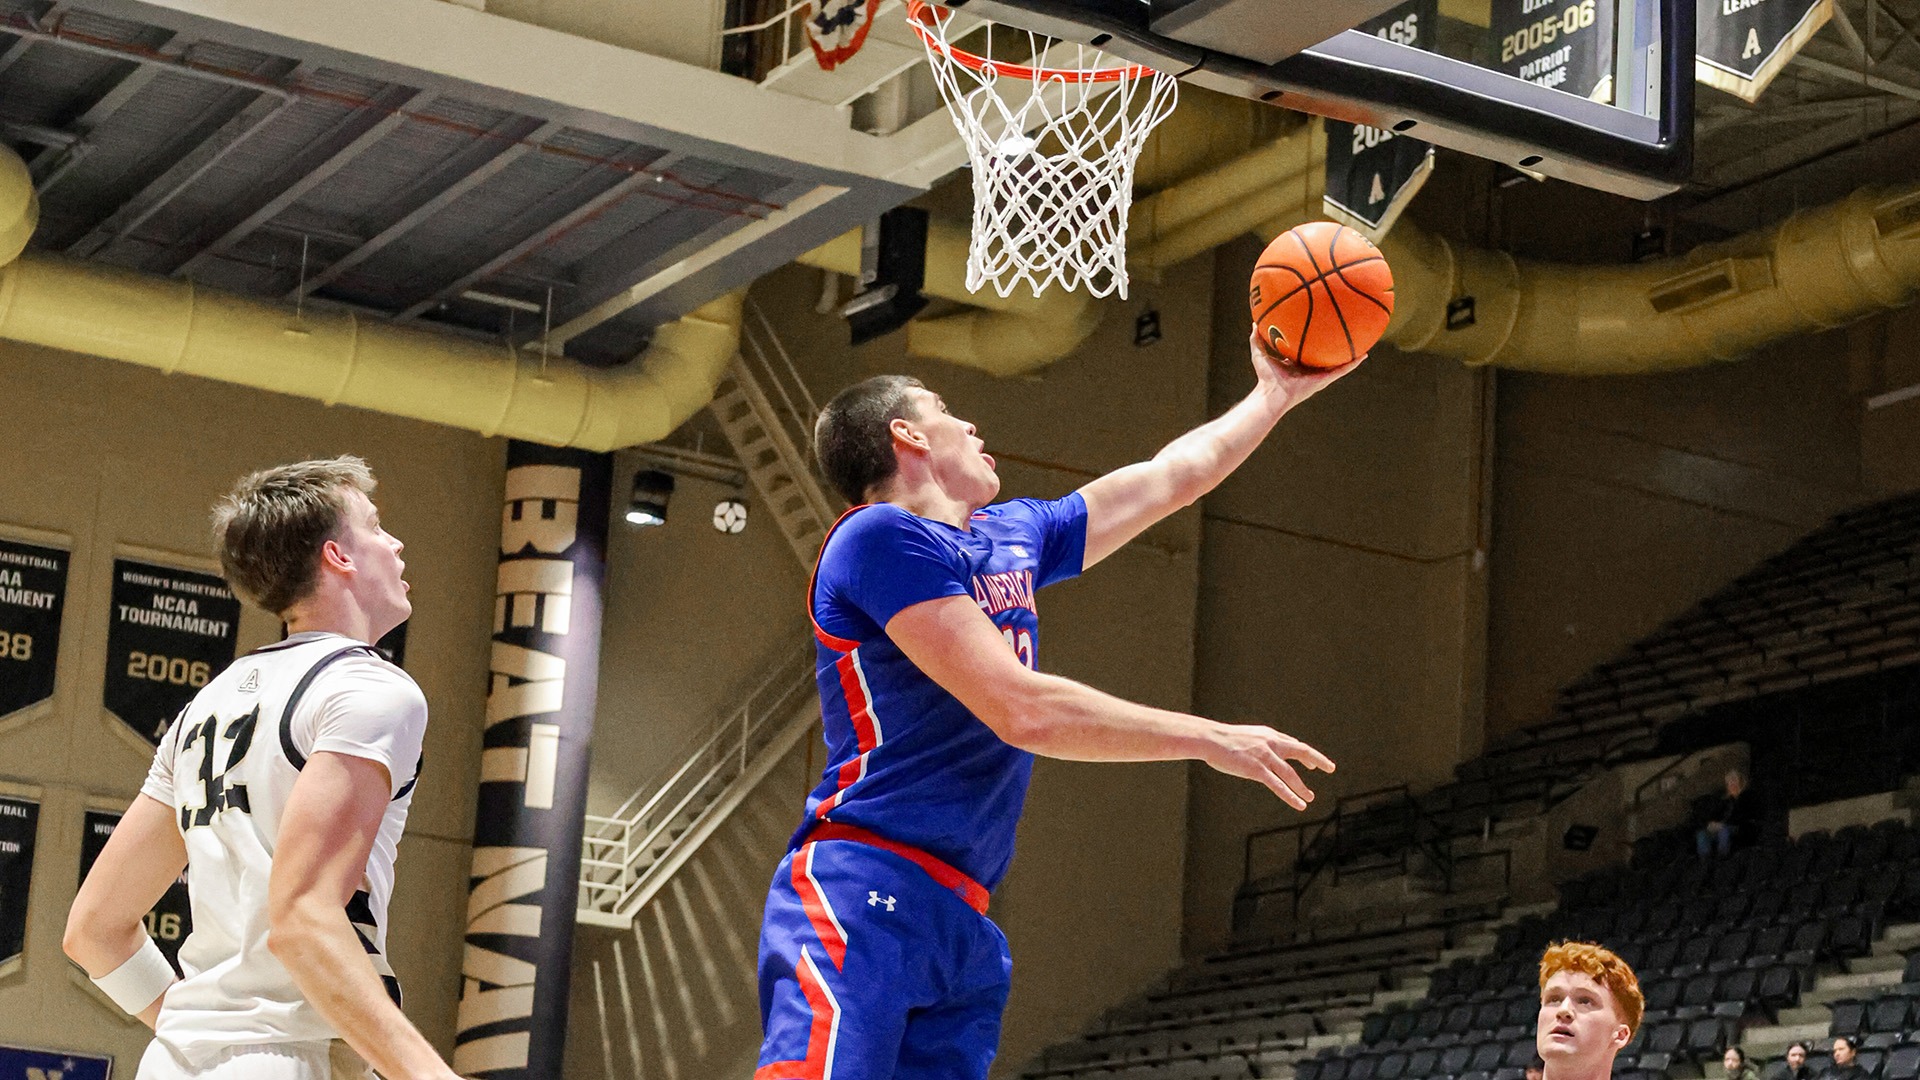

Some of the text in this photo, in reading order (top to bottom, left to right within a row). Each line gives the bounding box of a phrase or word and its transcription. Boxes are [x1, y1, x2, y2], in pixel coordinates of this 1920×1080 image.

[1502, 0, 1596, 63] 2005-06
[1741, 27, 1762, 59] A
[1520, 45, 1572, 80] PATRIOT
[1367, 173, 1385, 204] A
[0, 551, 58, 571] ASKETBALL
[123, 571, 233, 600] WOMEN'S BASKETBALL
[153, 594, 199, 616] NCAA
[119, 605, 230, 638] TOURNAMENT
[480, 464, 581, 810] BEAT
[127, 651, 211, 688] 2006
[238, 667, 261, 693] A
